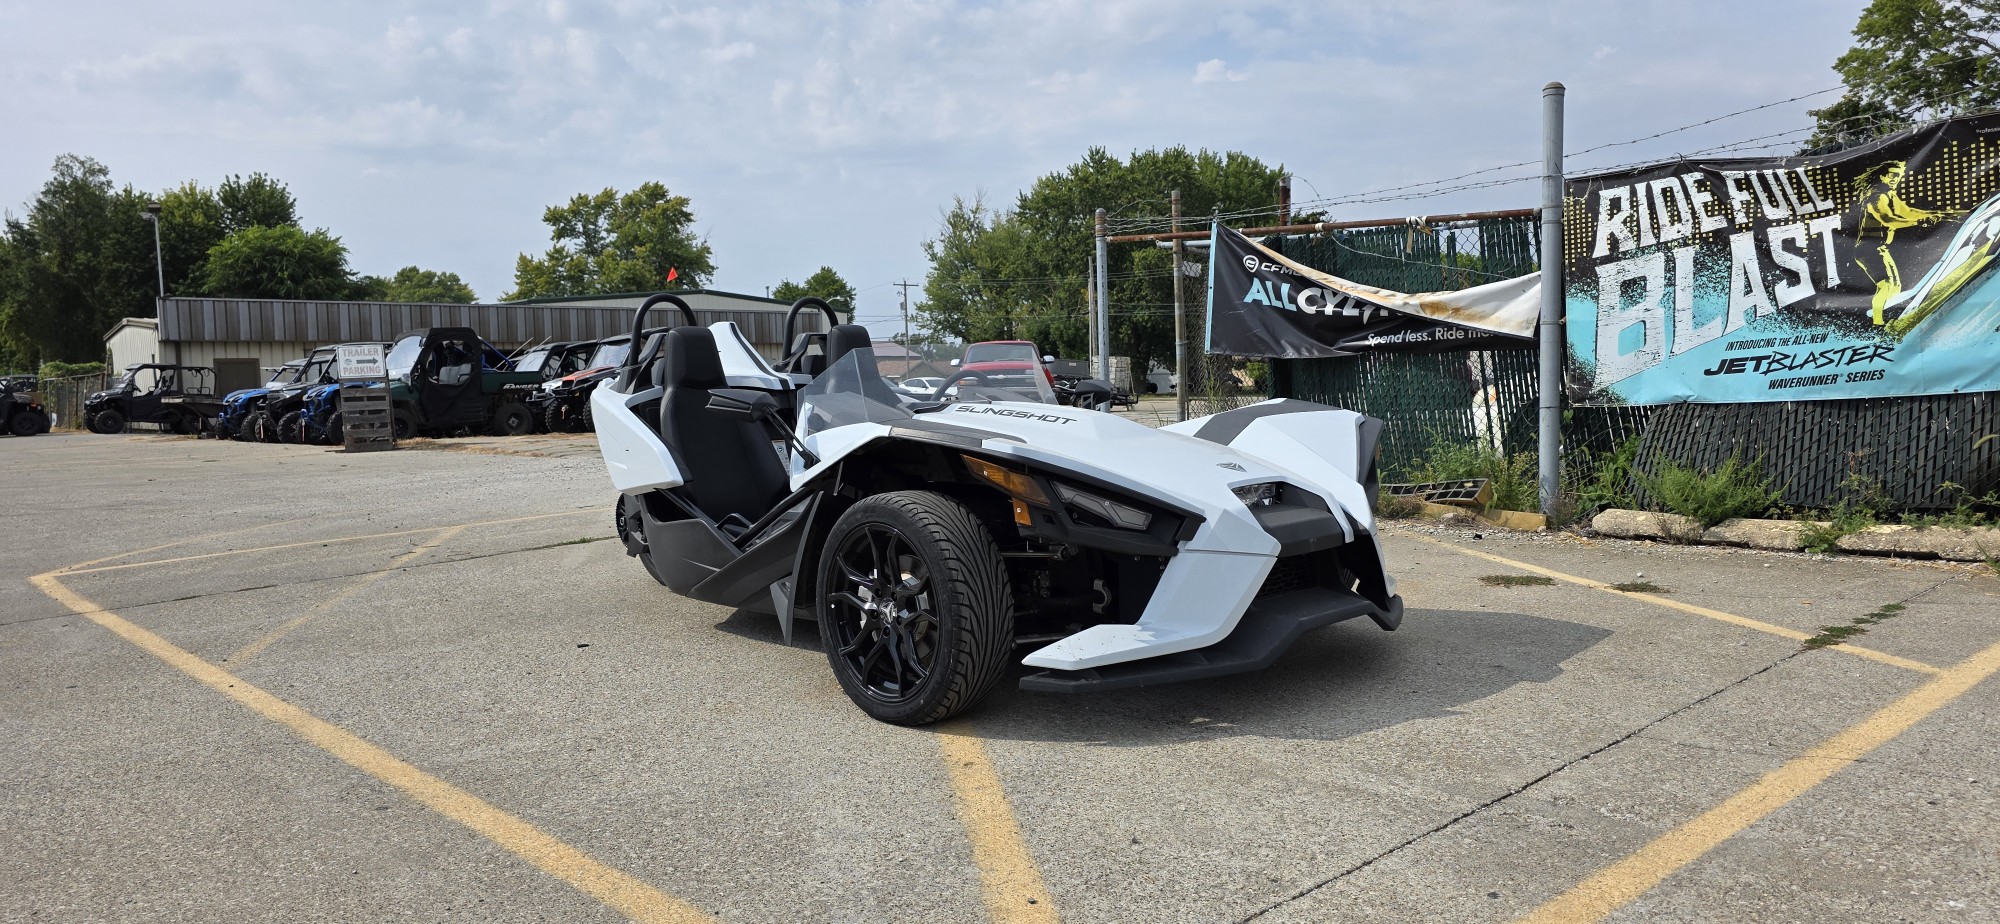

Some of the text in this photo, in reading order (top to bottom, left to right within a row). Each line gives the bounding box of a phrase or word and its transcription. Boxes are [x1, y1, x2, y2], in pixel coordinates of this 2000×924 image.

[1592, 167, 1835, 258] RIDE FULL
[1591, 213, 1842, 394] BLAST
[1366, 329, 1402, 347] Spend
[1405, 329, 1432, 342] less.
[1435, 327, 1465, 340] Ride
[1725, 331, 1829, 352] INTRODUCING THE ALL-NEW
[342, 347, 379, 357] TRAILER
[343, 366, 381, 375] PARKING
[1845, 369, 1886, 384] SERIES
[955, 405, 1078, 425] SLINGSHOT
